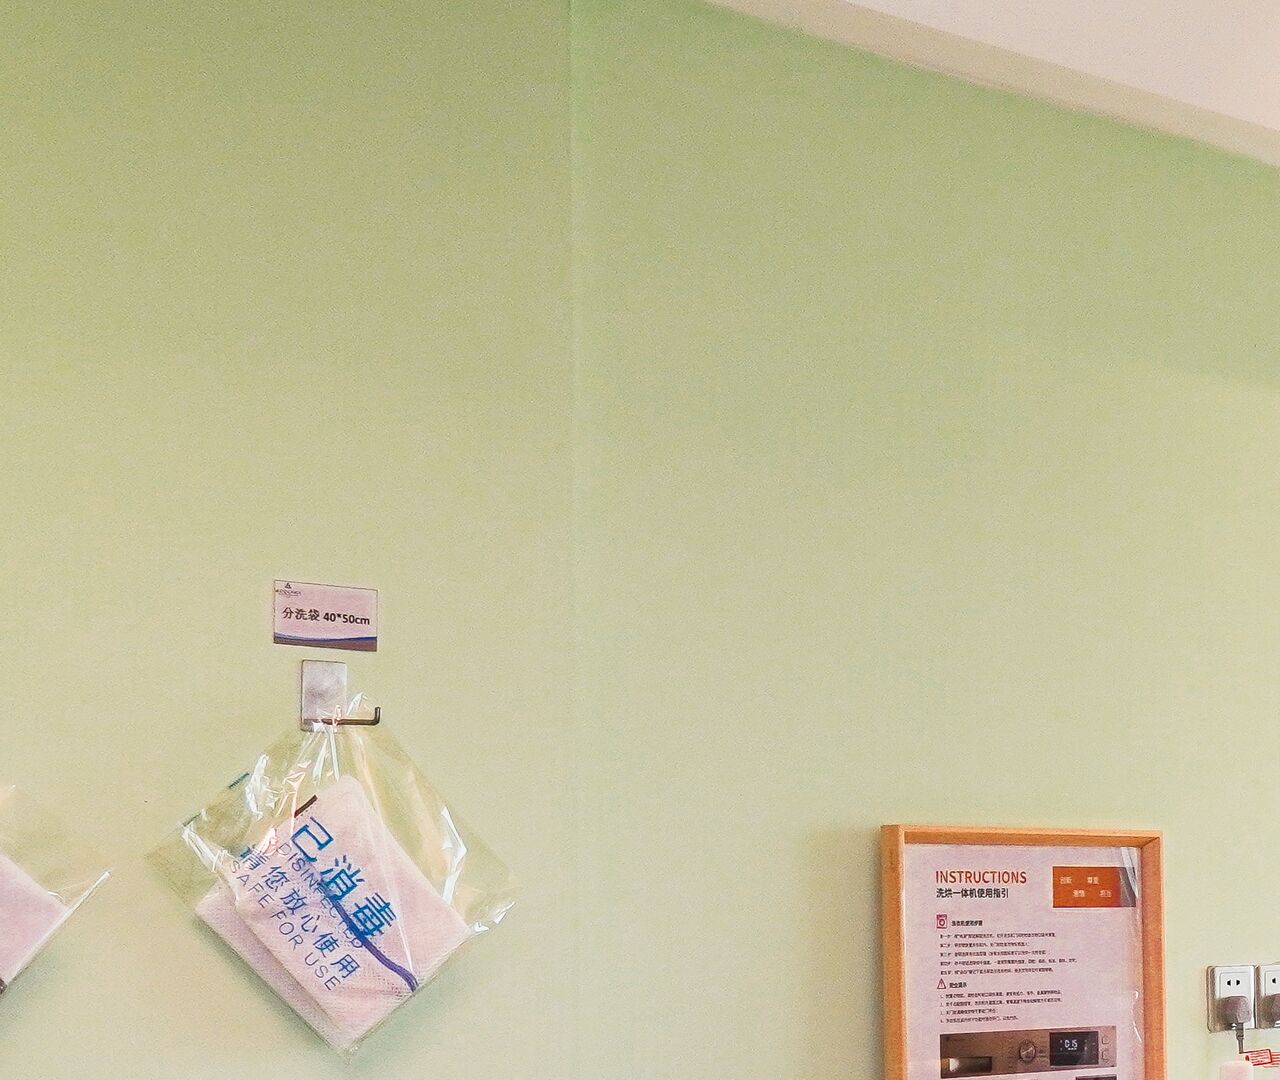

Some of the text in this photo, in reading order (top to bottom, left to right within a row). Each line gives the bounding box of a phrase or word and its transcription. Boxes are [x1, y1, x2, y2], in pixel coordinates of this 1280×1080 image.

[282, 607, 320, 622] 分洗袋
[290, 816, 397, 937] 已消毒
[935, 869, 1028, 884] INSTRUCTIONS
[936, 887, 1009, 899] 洗烘一体机使用指引
[230, 859, 341, 991] SAFE FOR USE
